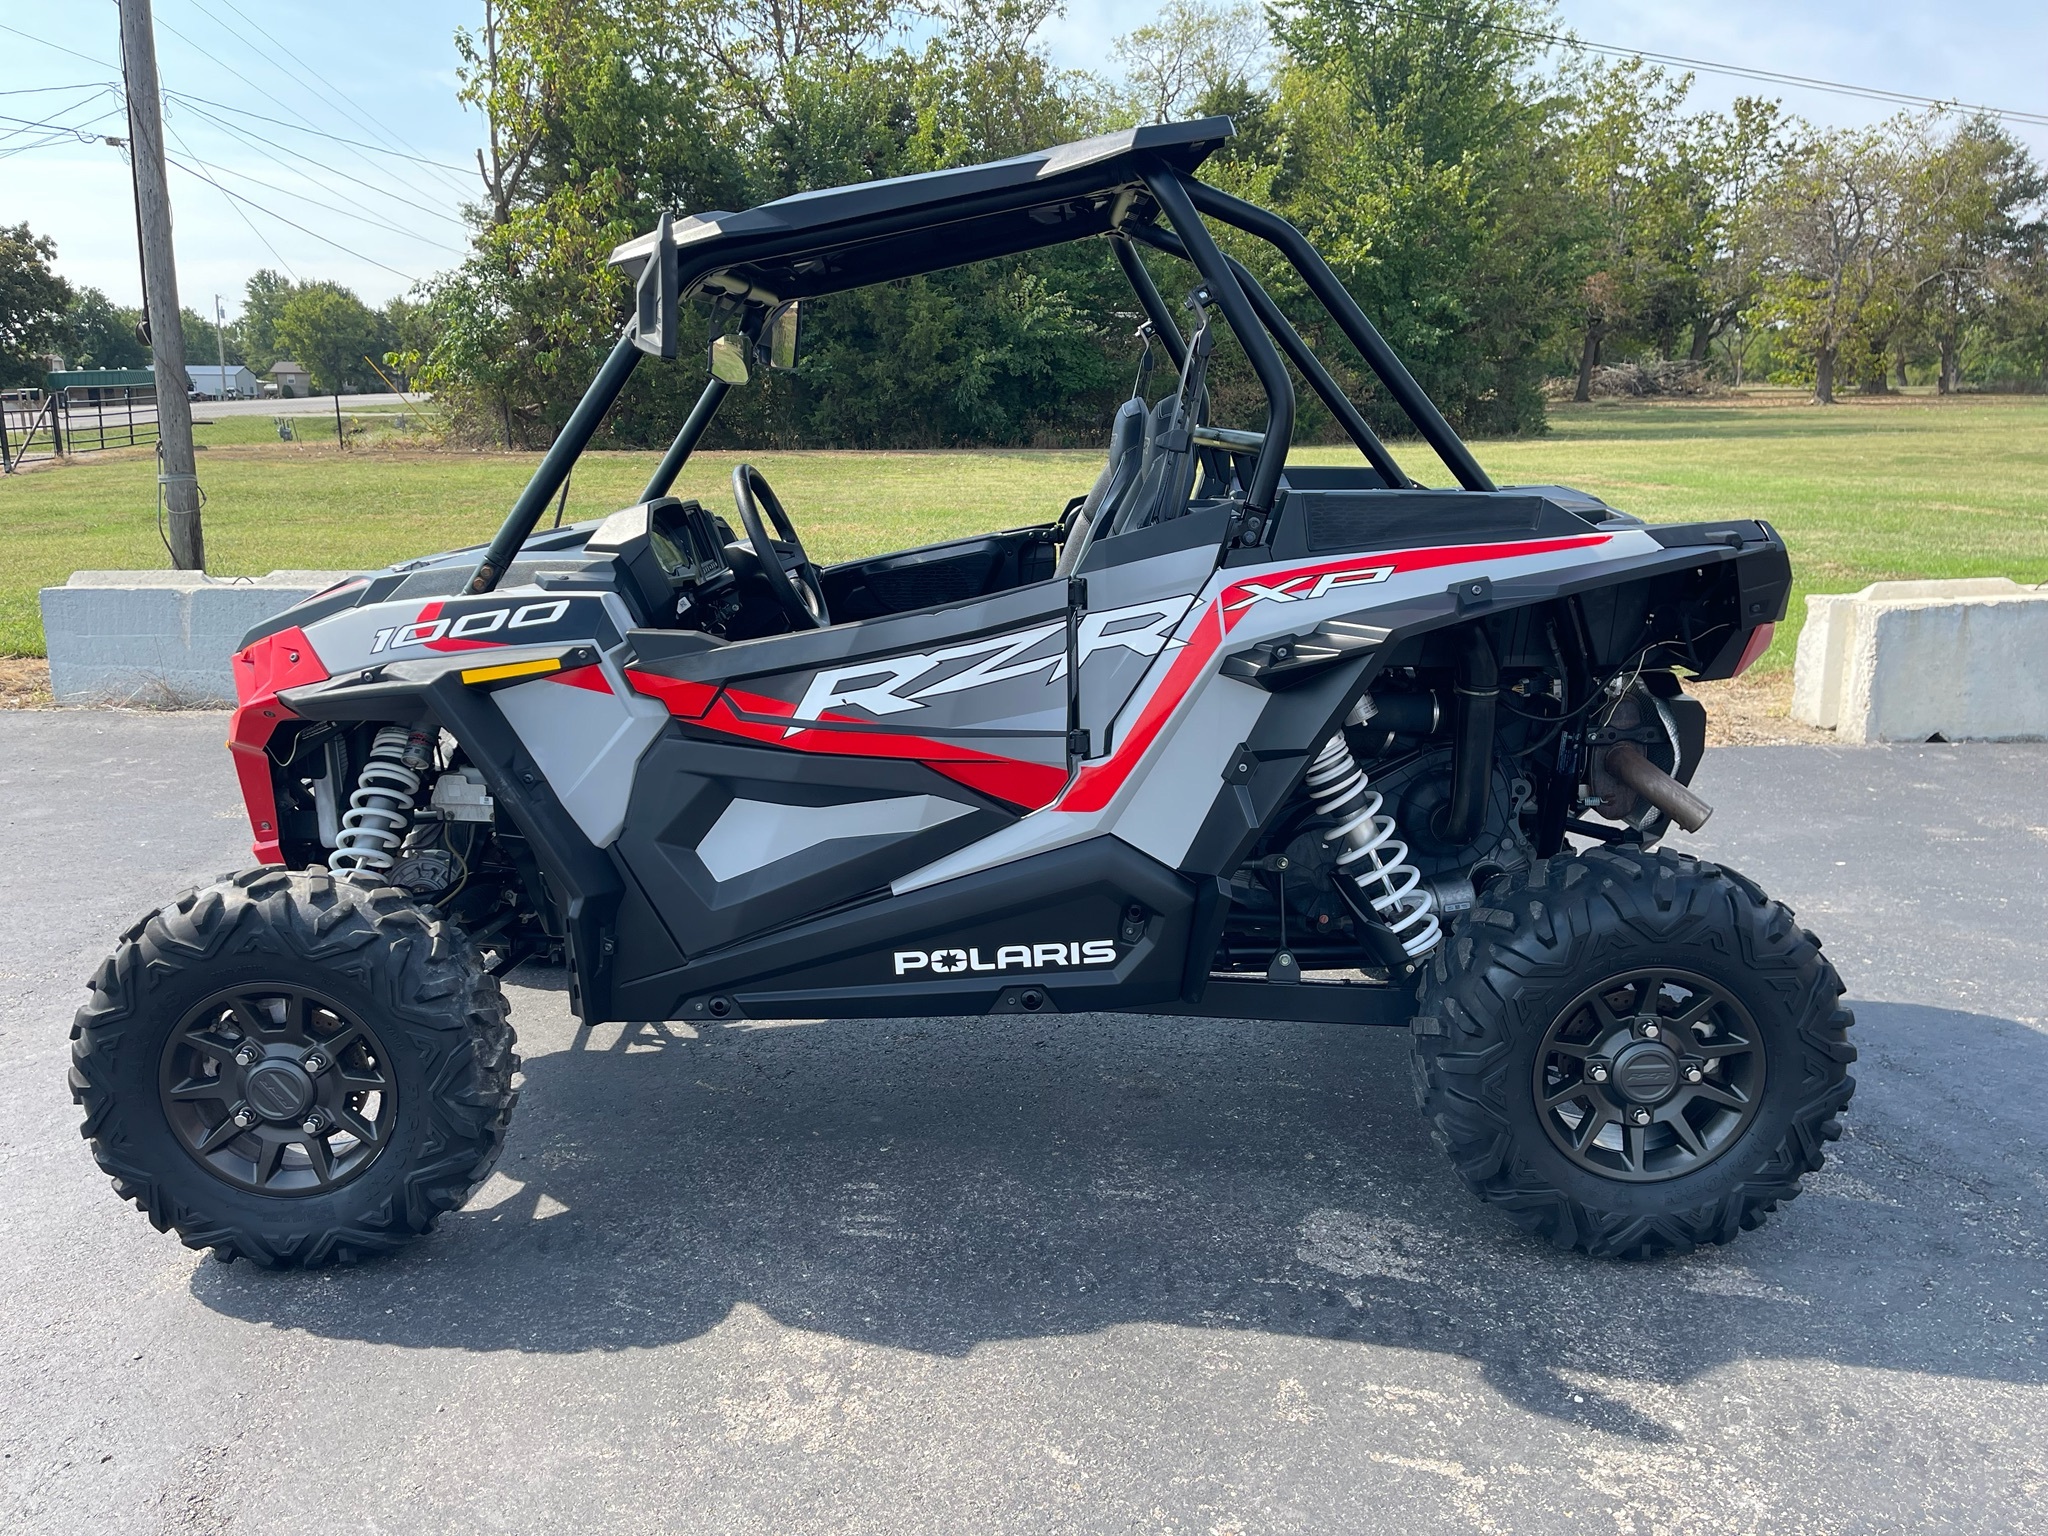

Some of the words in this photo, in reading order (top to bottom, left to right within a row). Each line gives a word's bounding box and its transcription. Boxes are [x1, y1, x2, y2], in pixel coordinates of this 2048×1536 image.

[1216, 565, 1397, 613] XP
[371, 599, 570, 654] 1000
[783, 593, 1206, 738] RZR
[894, 939, 1117, 975] POLARIS
